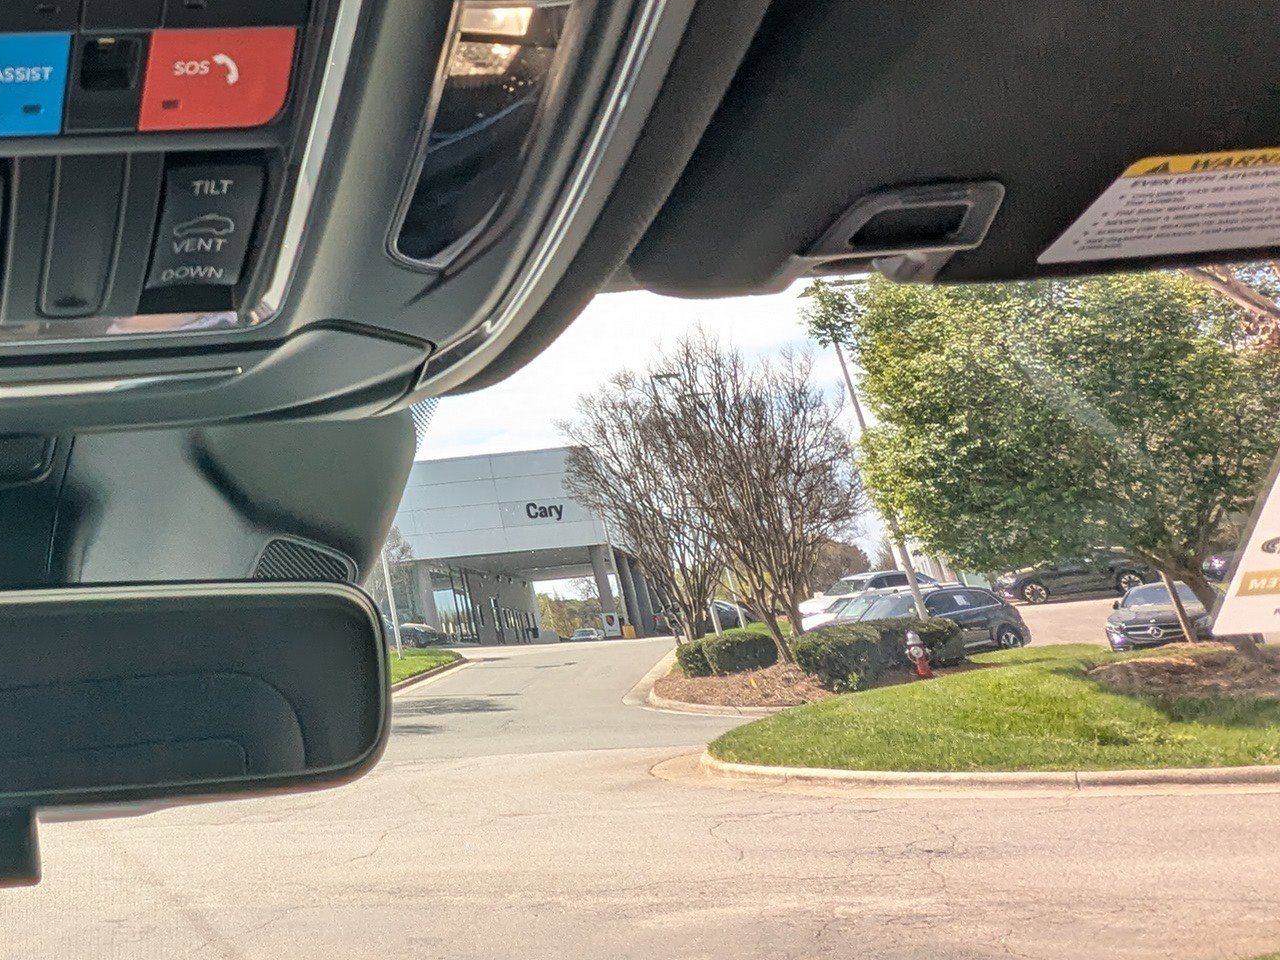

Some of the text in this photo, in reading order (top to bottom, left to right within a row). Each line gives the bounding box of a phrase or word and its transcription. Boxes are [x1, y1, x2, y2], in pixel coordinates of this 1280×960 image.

[173, 59, 210, 76] SOS
[193, 179, 234, 196] TILT
[172, 238, 227, 254] VENT
[161, 265, 224, 282] DOWN
[525, 502, 564, 521] Cary
